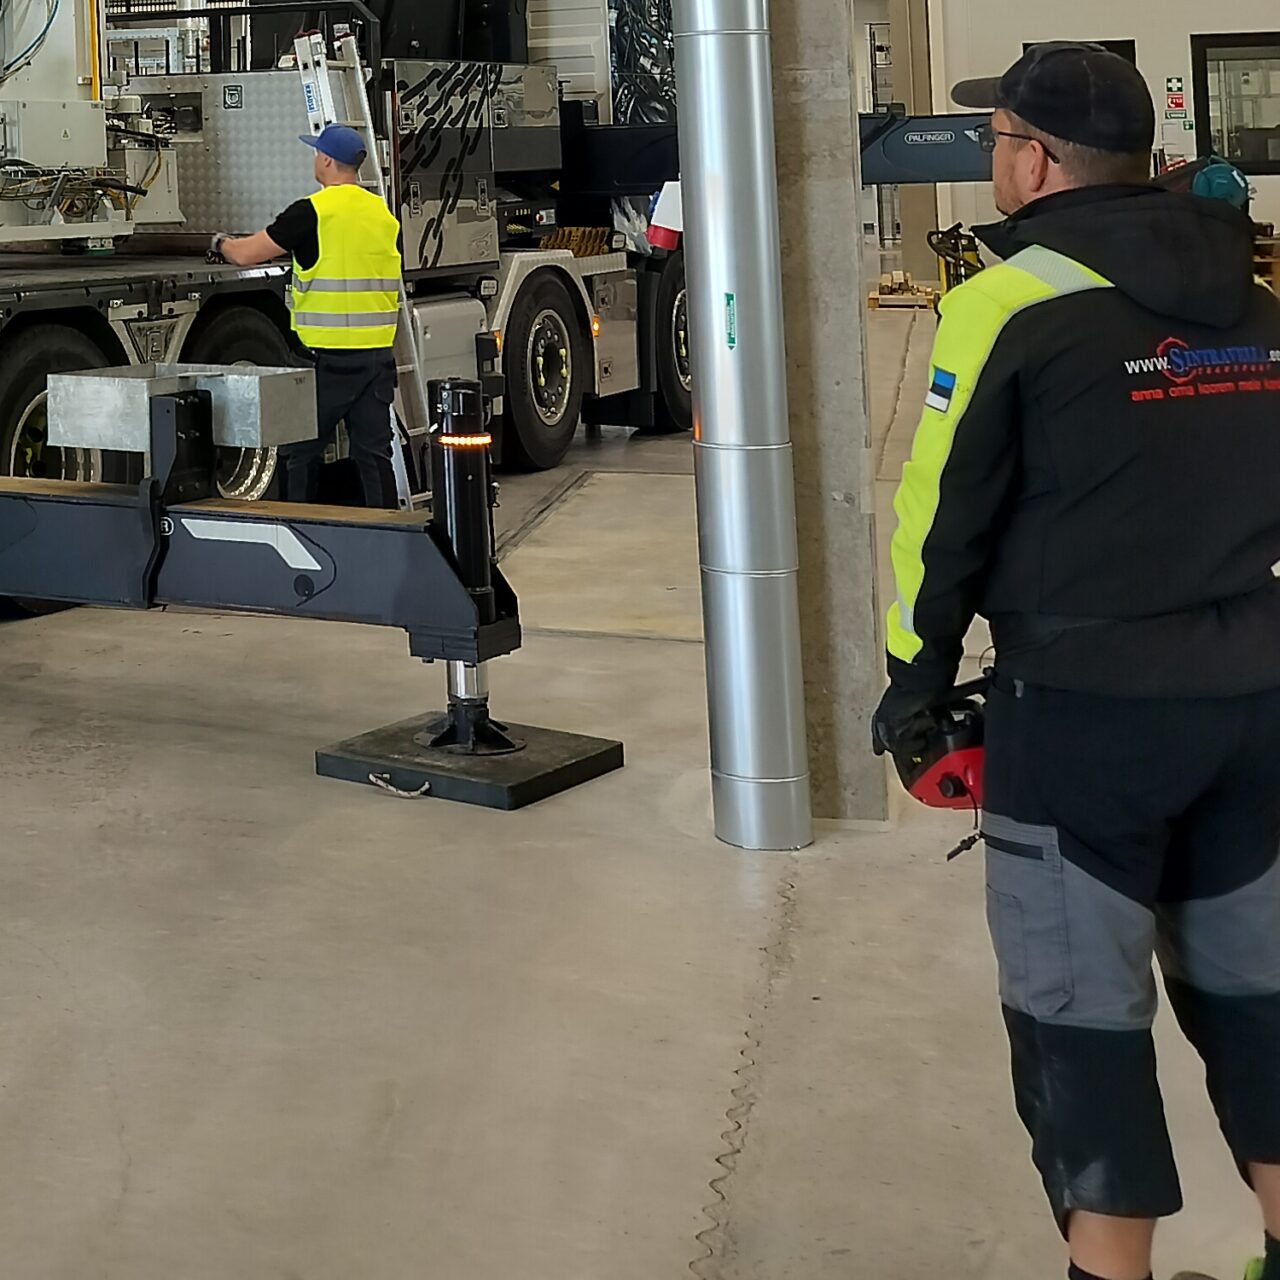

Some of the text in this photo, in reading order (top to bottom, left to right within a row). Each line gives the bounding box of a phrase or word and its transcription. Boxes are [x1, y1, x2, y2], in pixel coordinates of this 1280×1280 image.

[908, 133, 951, 142] PALFINGER
[1131, 388, 1164, 401] anna
[1169, 385, 1195, 397] oma
